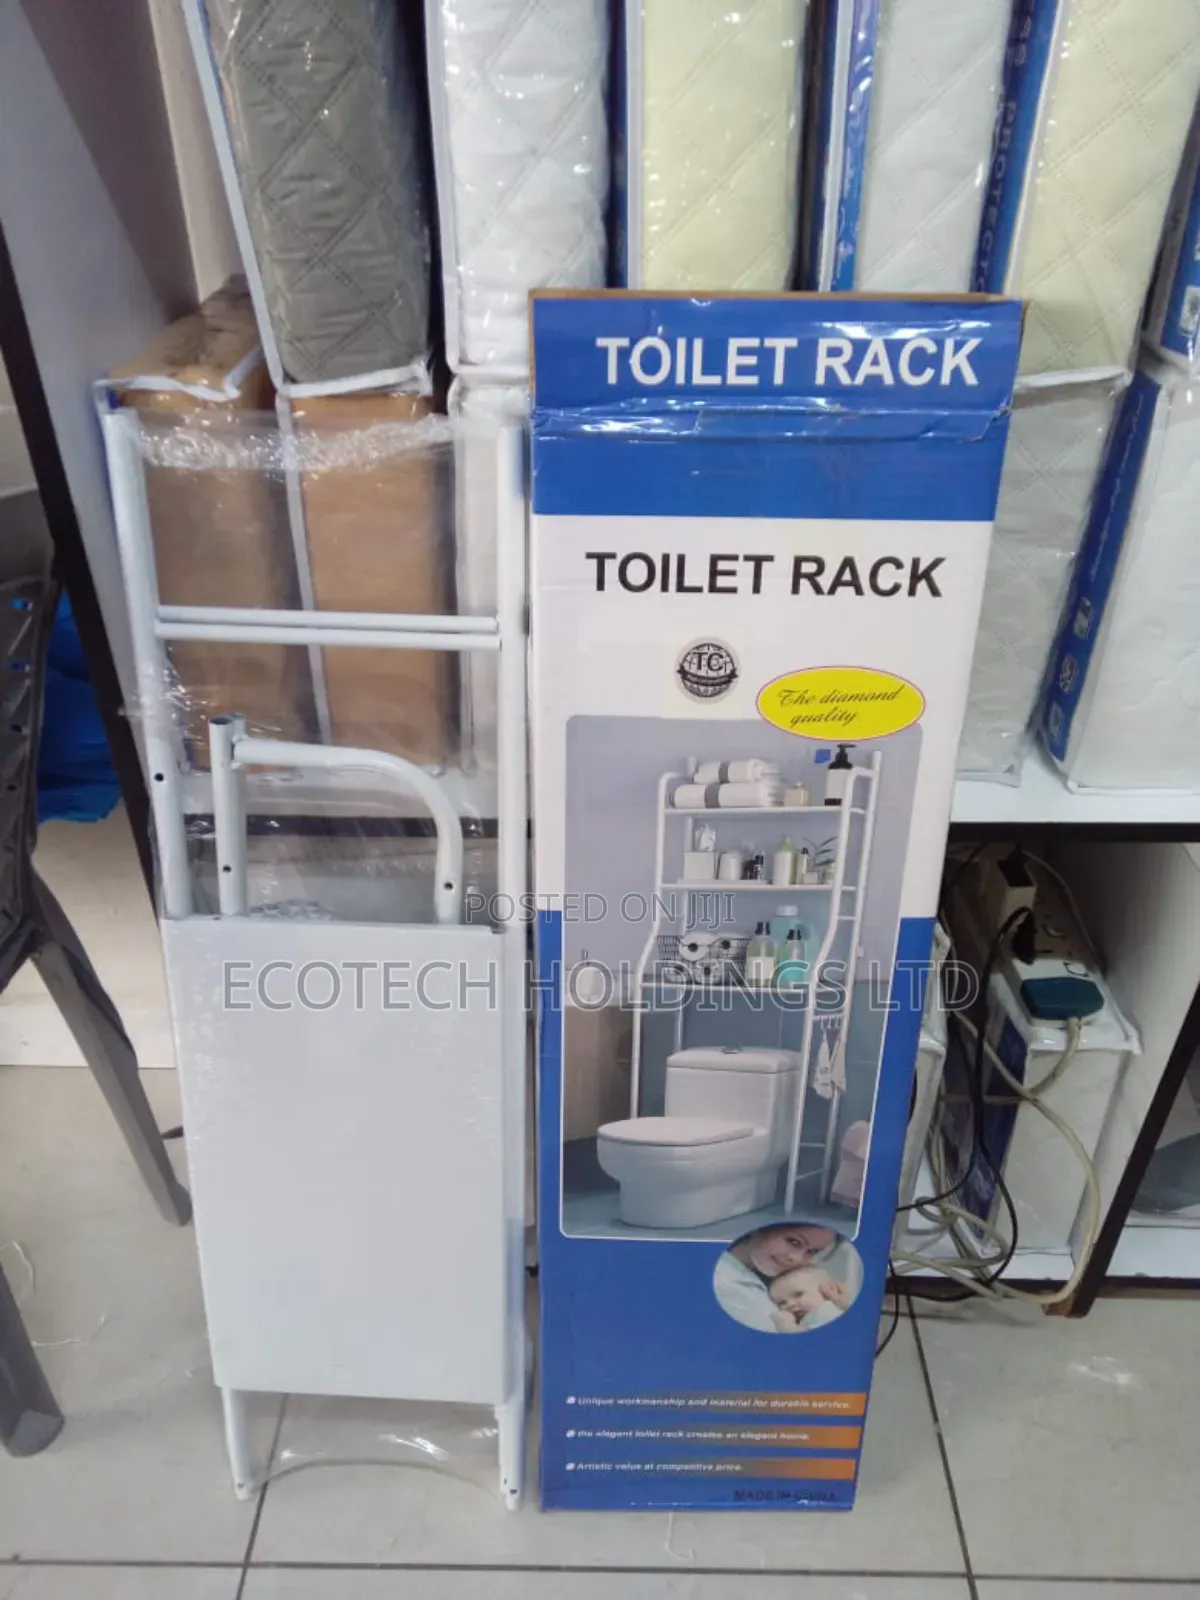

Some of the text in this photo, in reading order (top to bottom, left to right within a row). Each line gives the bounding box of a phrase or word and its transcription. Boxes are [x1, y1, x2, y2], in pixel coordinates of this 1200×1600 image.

[596, 336, 983, 386] TOILET RACK
[585, 552, 946, 598] TOILET RACK
[692, 651, 724, 671] TC
[778, 683, 905, 707] The diamond
[789, 706, 859, 728] quality
[688, 1397, 708, 1406] and
[734, 1490, 773, 1501] MADE
